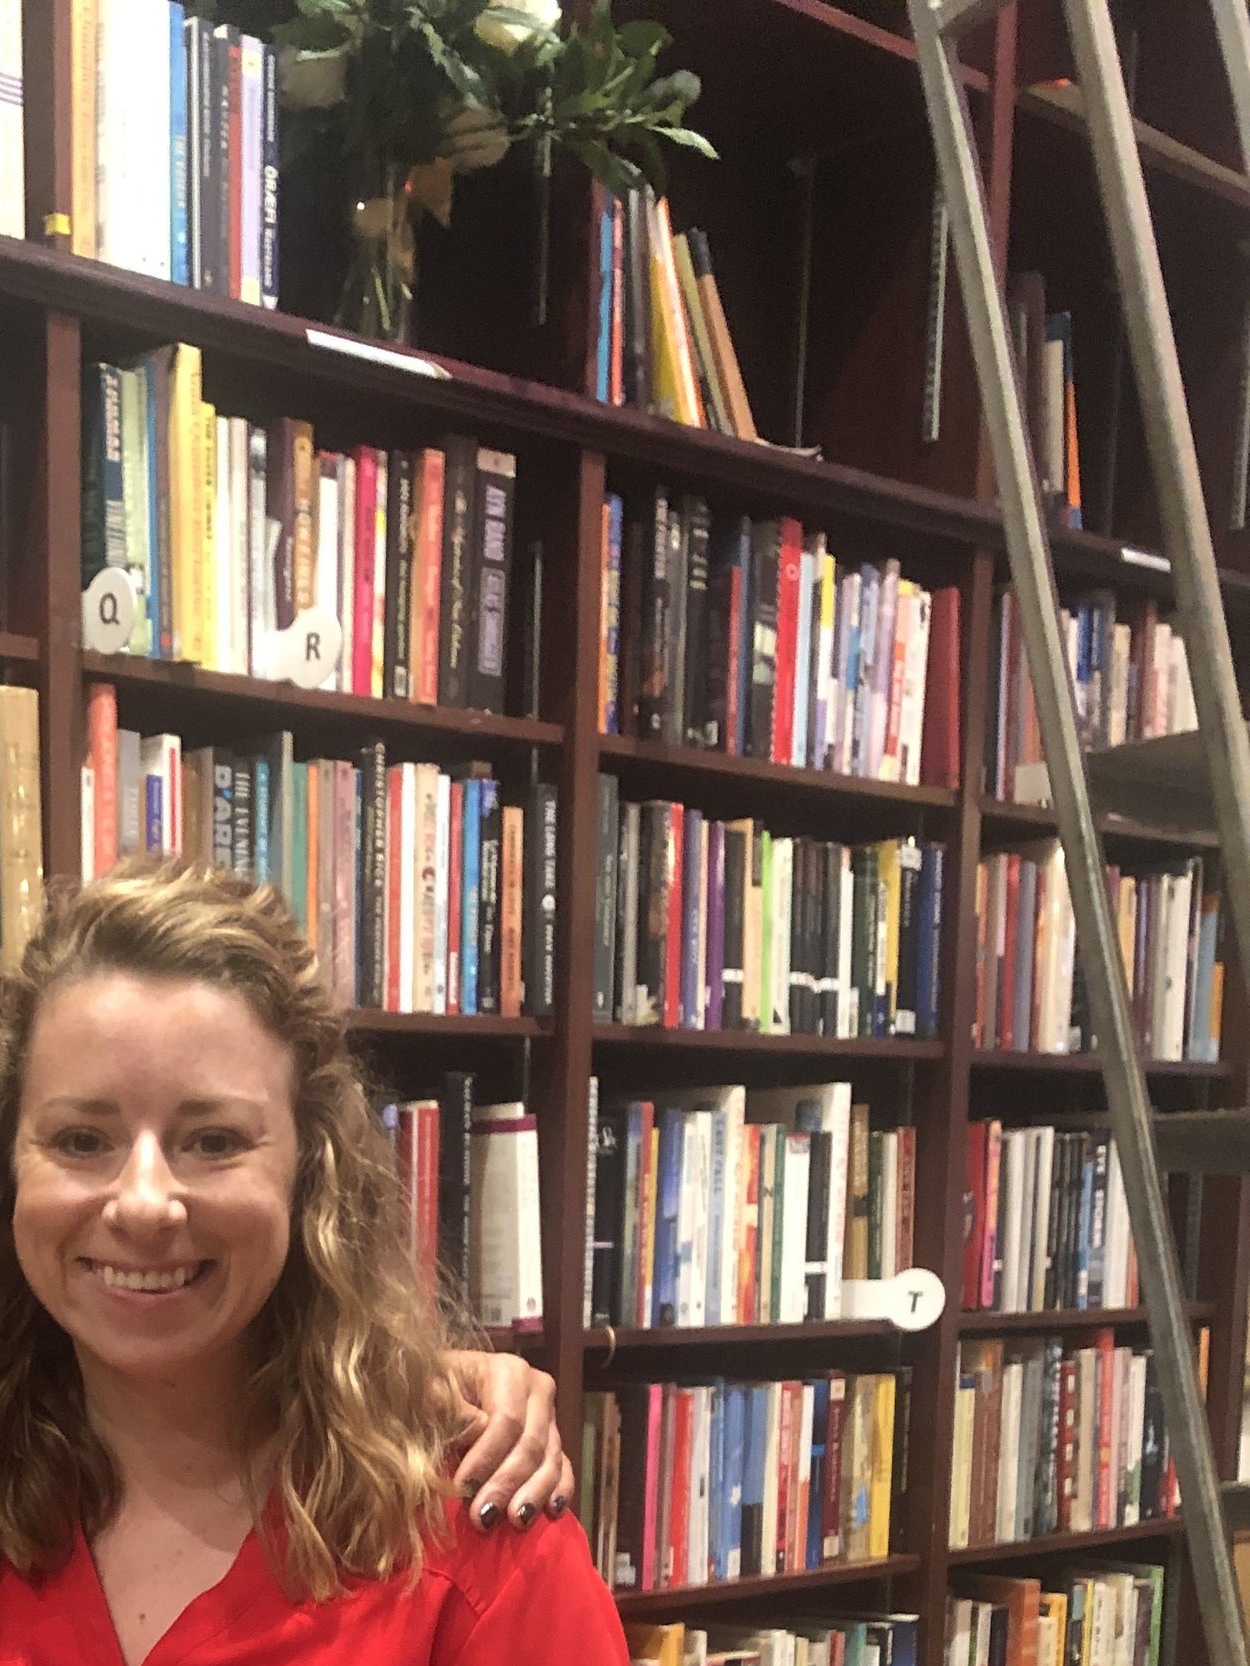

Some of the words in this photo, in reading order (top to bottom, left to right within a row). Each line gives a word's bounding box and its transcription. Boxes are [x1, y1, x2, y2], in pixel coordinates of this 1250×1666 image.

[100, 593, 120, 626] Q
[306, 632, 321, 662] R
[908, 1291, 923, 1314] T
